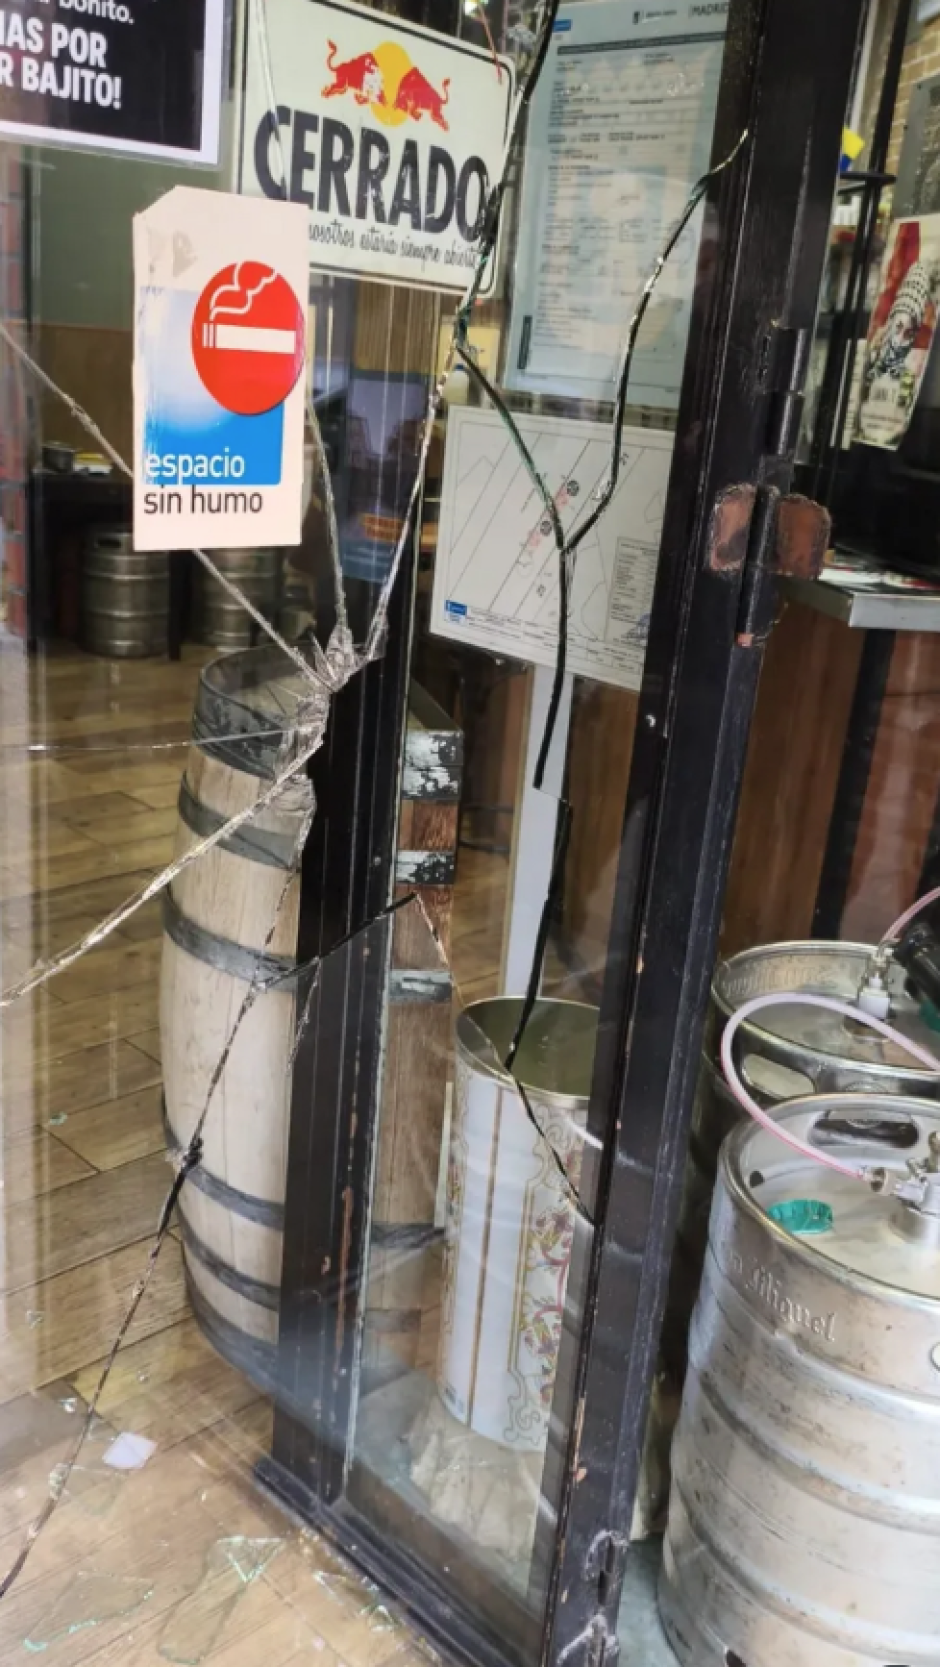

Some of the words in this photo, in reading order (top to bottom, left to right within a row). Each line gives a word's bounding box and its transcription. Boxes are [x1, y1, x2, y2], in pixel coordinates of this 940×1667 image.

[51, 23, 107, 68] POR
[22, 56, 122, 110] BAJITO!
[254, 105, 490, 243] CERRADO
[145, 446, 245, 485] espacio
[143, 484, 182, 514] sin
[190, 484, 263, 514] humo
